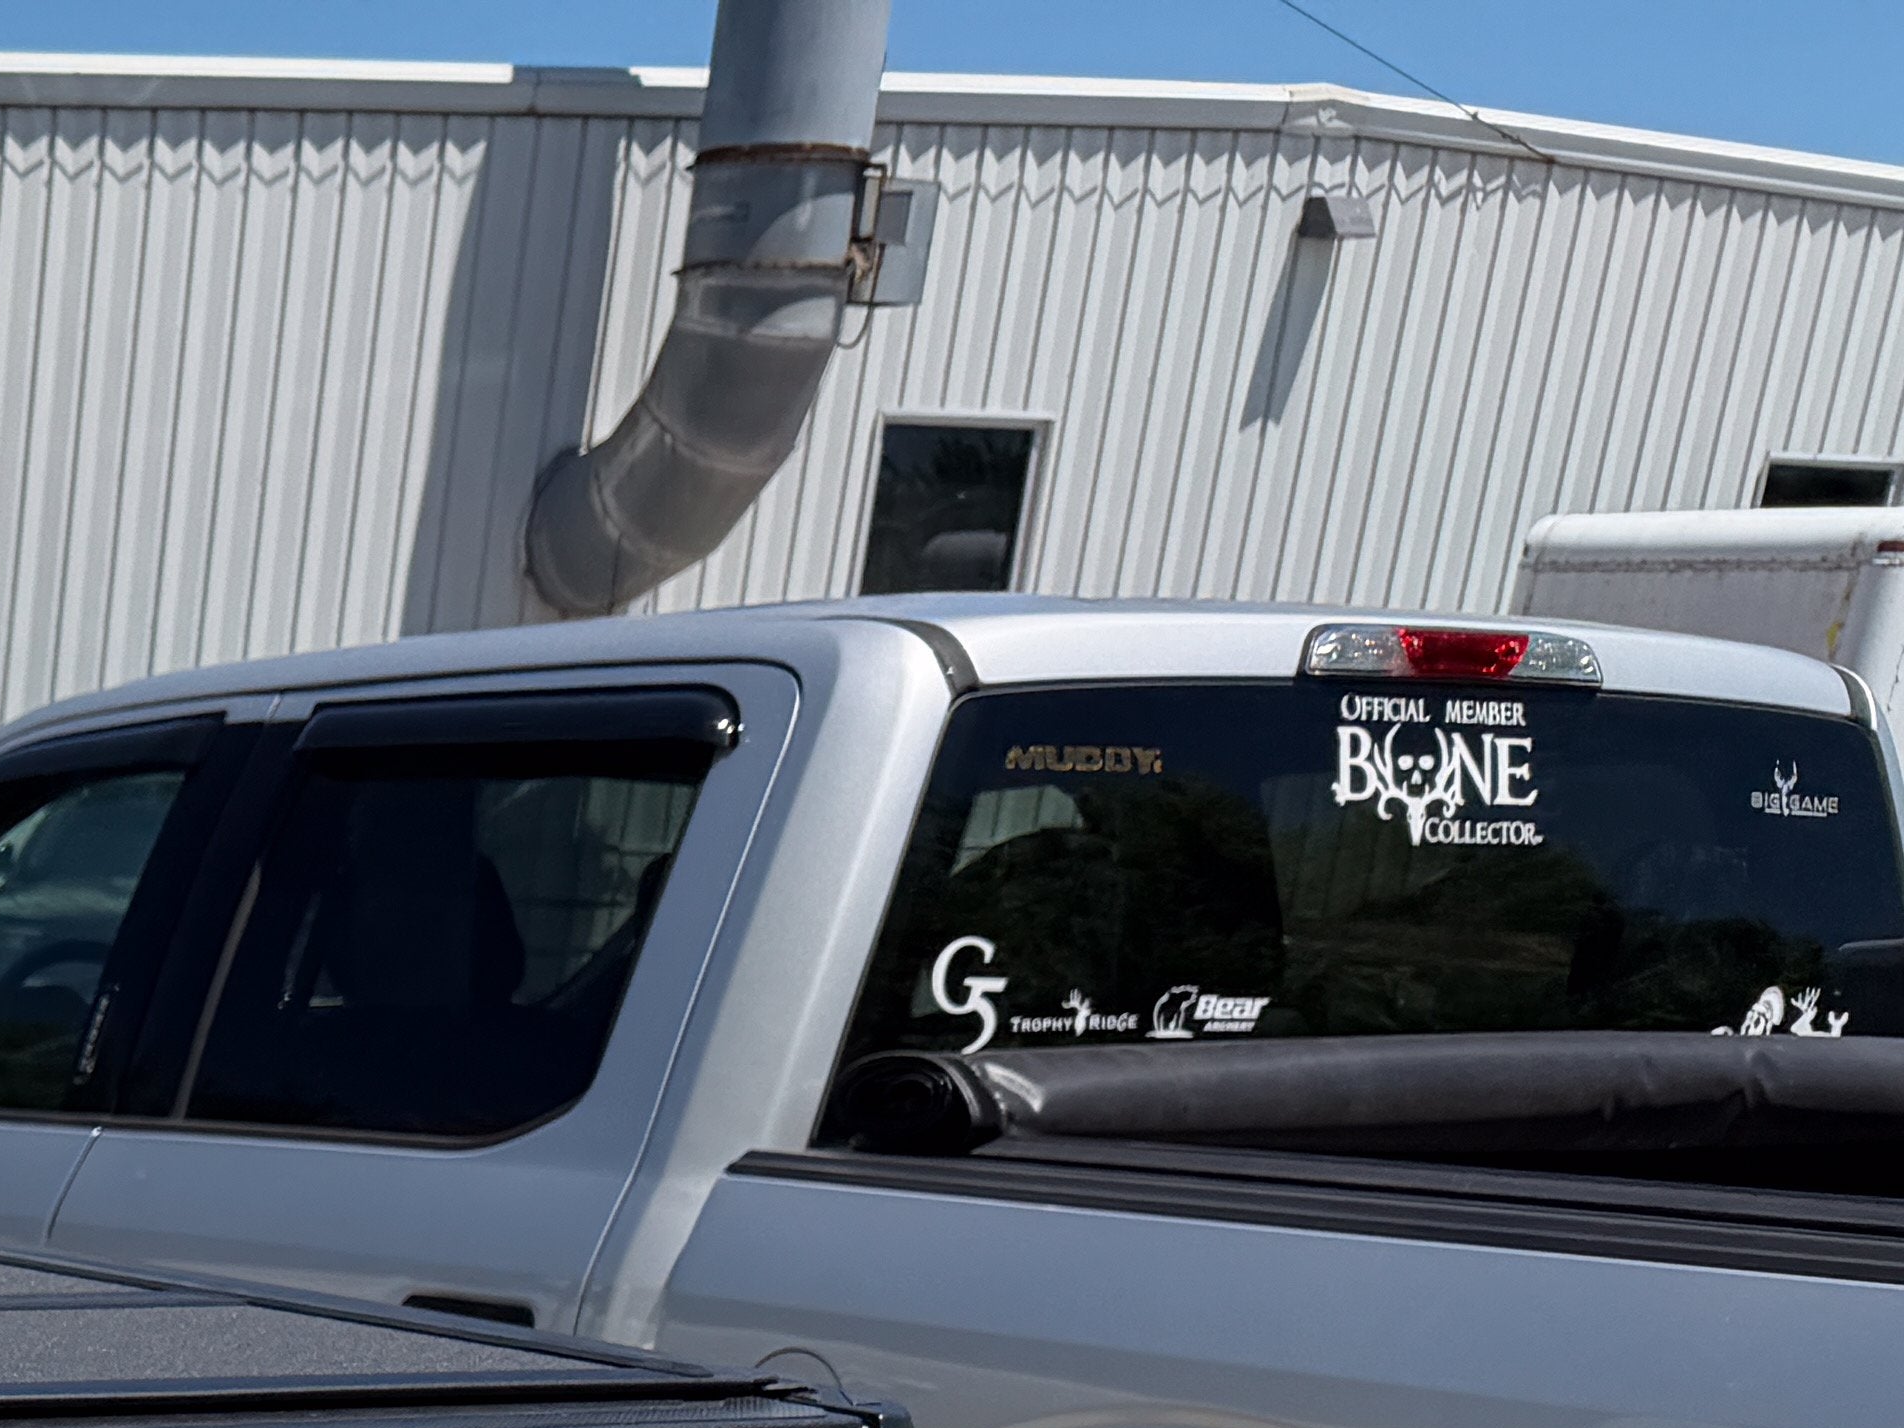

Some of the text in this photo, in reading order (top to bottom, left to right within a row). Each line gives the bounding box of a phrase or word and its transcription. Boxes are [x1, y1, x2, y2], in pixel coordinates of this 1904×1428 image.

[1340, 693, 1527, 727] OFFICIAL MEMBER
[1789, 794, 1839, 814] GAME
[1424, 816, 1540, 846] COLLECTOR
[1193, 994, 1272, 1020] Bear
[1010, 1012, 1140, 1033] TROPHY RIDGE
